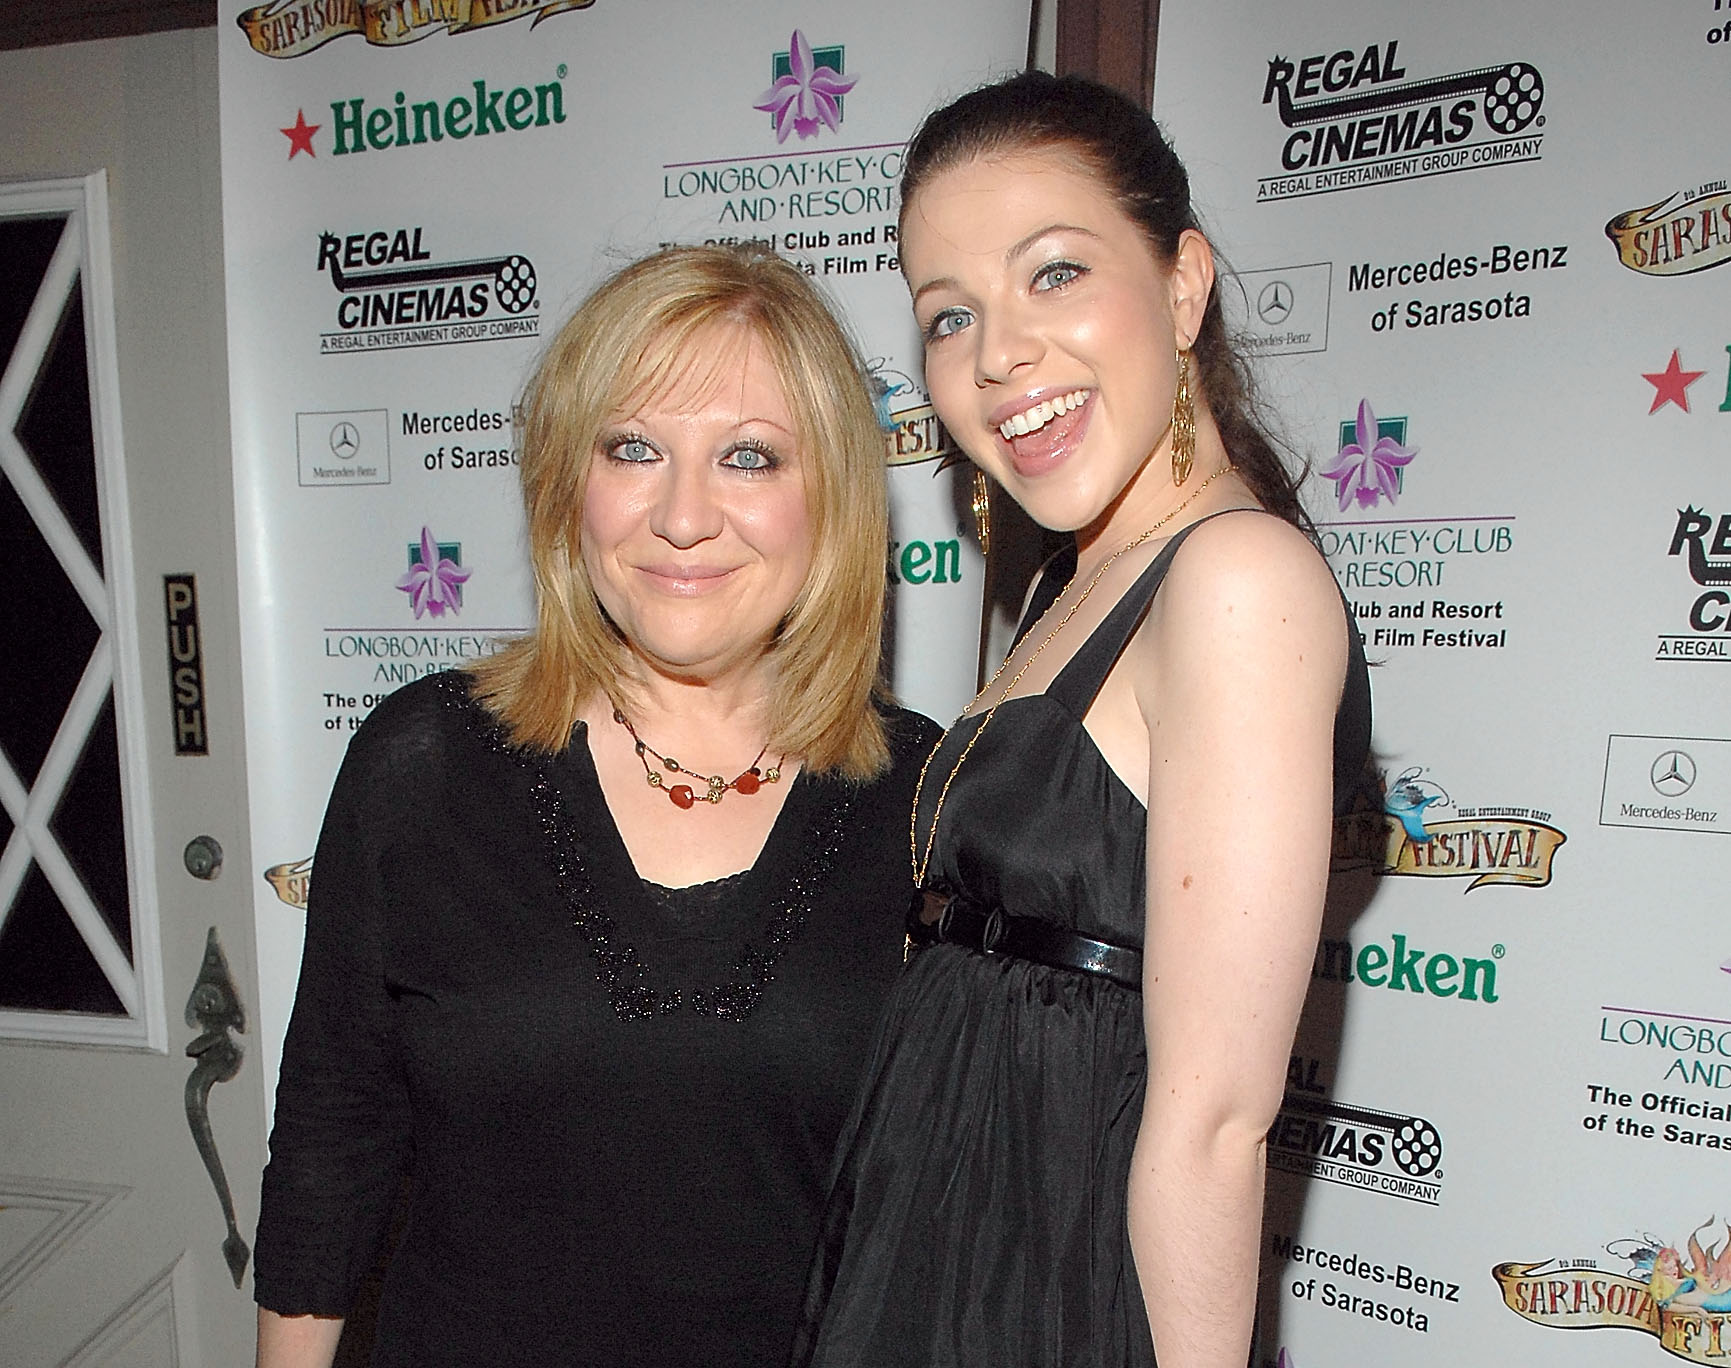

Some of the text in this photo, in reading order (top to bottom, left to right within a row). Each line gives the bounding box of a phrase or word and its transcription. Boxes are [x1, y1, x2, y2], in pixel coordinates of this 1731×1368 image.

[1262, 40, 1406, 104] REGAL
[330, 79, 566, 156] Heineken
[1281, 100, 1477, 171] CINEMAS
[1258, 139, 1543, 198] A REGAL ENTERTAINMENT GROUP COMPANY
[317, 227, 430, 271] REGAL
[784, 230, 830, 250] Club
[838, 226, 876, 246] and
[824, 256, 867, 276] Film
[1348, 245, 1568, 292] Mercedes-Benz
[338, 283, 489, 330] CINEMAS
[1372, 291, 1531, 332] of Sarasota
[321, 319, 539, 350] A REGAL ENTERTAINMENT GROUP COMPANY
[424, 447, 445, 471] of
[1346, 560, 1445, 588] RESORT
[1350, 600, 1503, 619] lub and Resort
[1374, 628, 1415, 646] Film
[1422, 628, 1506, 648] Festival
[1657, 641, 1728, 656] A REGAL
[167, 582, 202, 747] PUSH
[323, 693, 357, 708] The
[325, 716, 341, 730] of
[1620, 803, 1717, 823] Mercedes-Benz
[1320, 934, 1499, 1004] neken
[1587, 1084, 1731, 1122] The Official
[1583, 1113, 1608, 1132] of
[1616, 1116, 1655, 1139] the
[1338, 1168, 1379, 1189] GROUP
[1381, 1177, 1440, 1201] COMPANY
[1272, 1235, 1460, 1302] Mercedes-Benz
[1291, 1279, 1429, 1333] of Sarasota
[1515, 1279, 1653, 1325] SARASOTA
